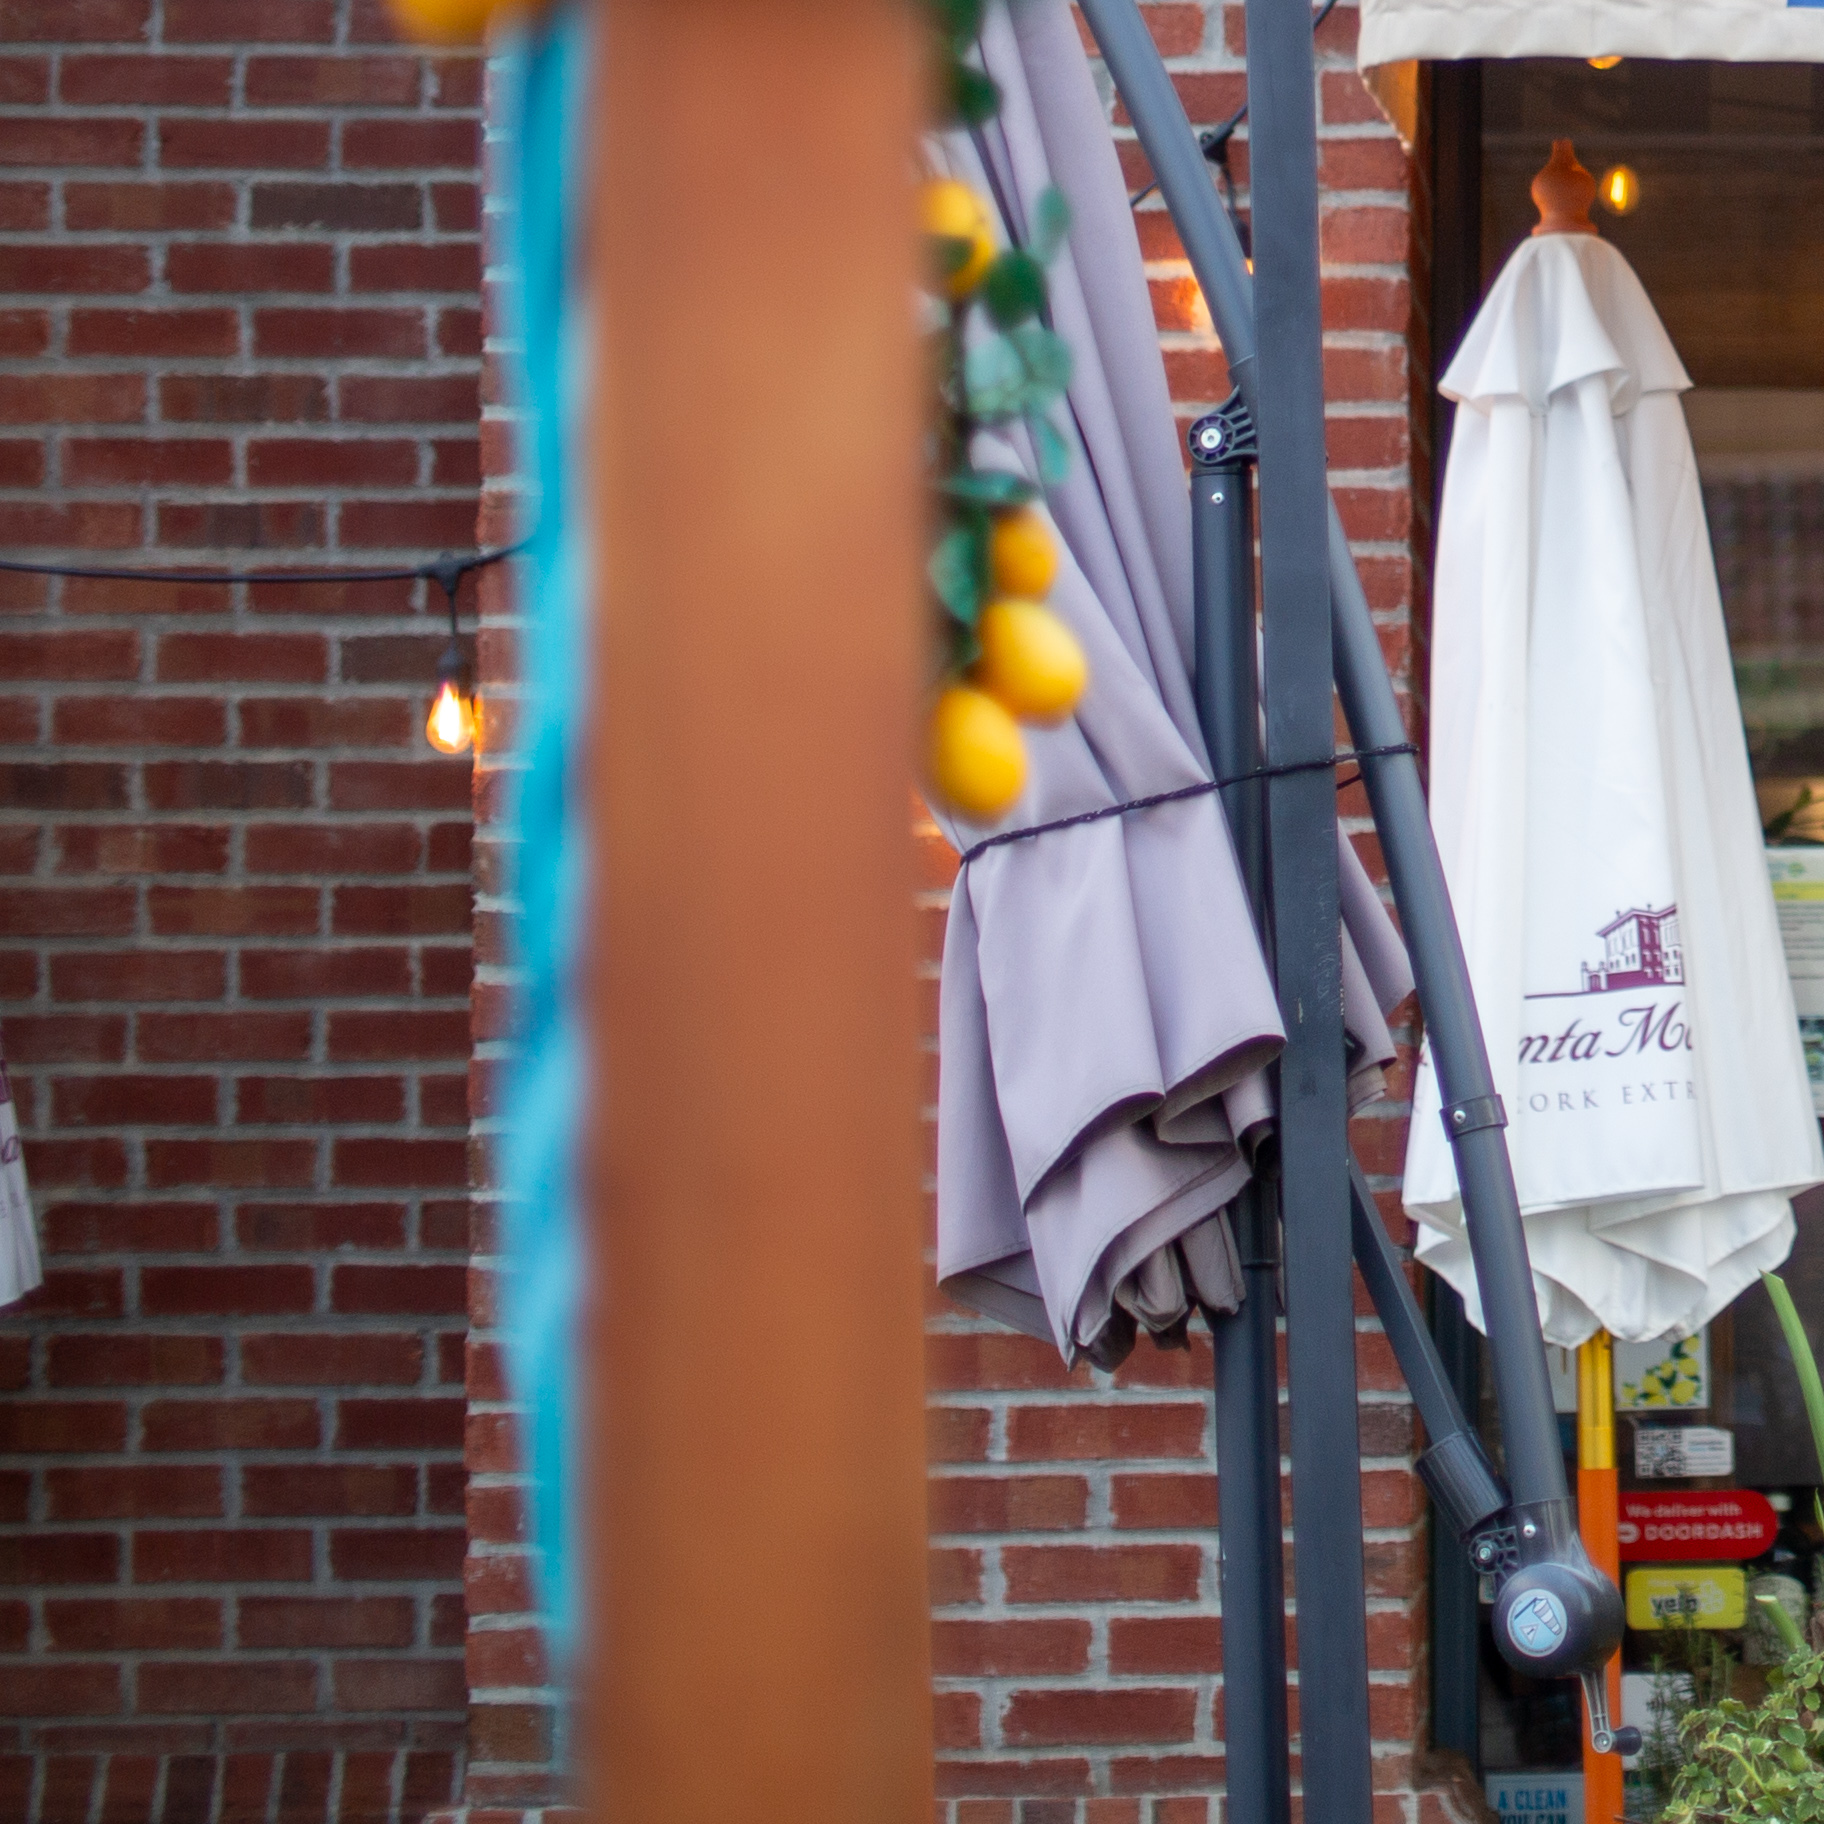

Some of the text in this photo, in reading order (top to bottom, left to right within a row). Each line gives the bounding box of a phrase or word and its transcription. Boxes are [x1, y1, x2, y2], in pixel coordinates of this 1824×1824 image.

[1517, 1089, 1599, 1116] ORK
[1644, 1522, 1764, 1542] DOORDASH
[1515, 1789, 1568, 1811] CLEAN
